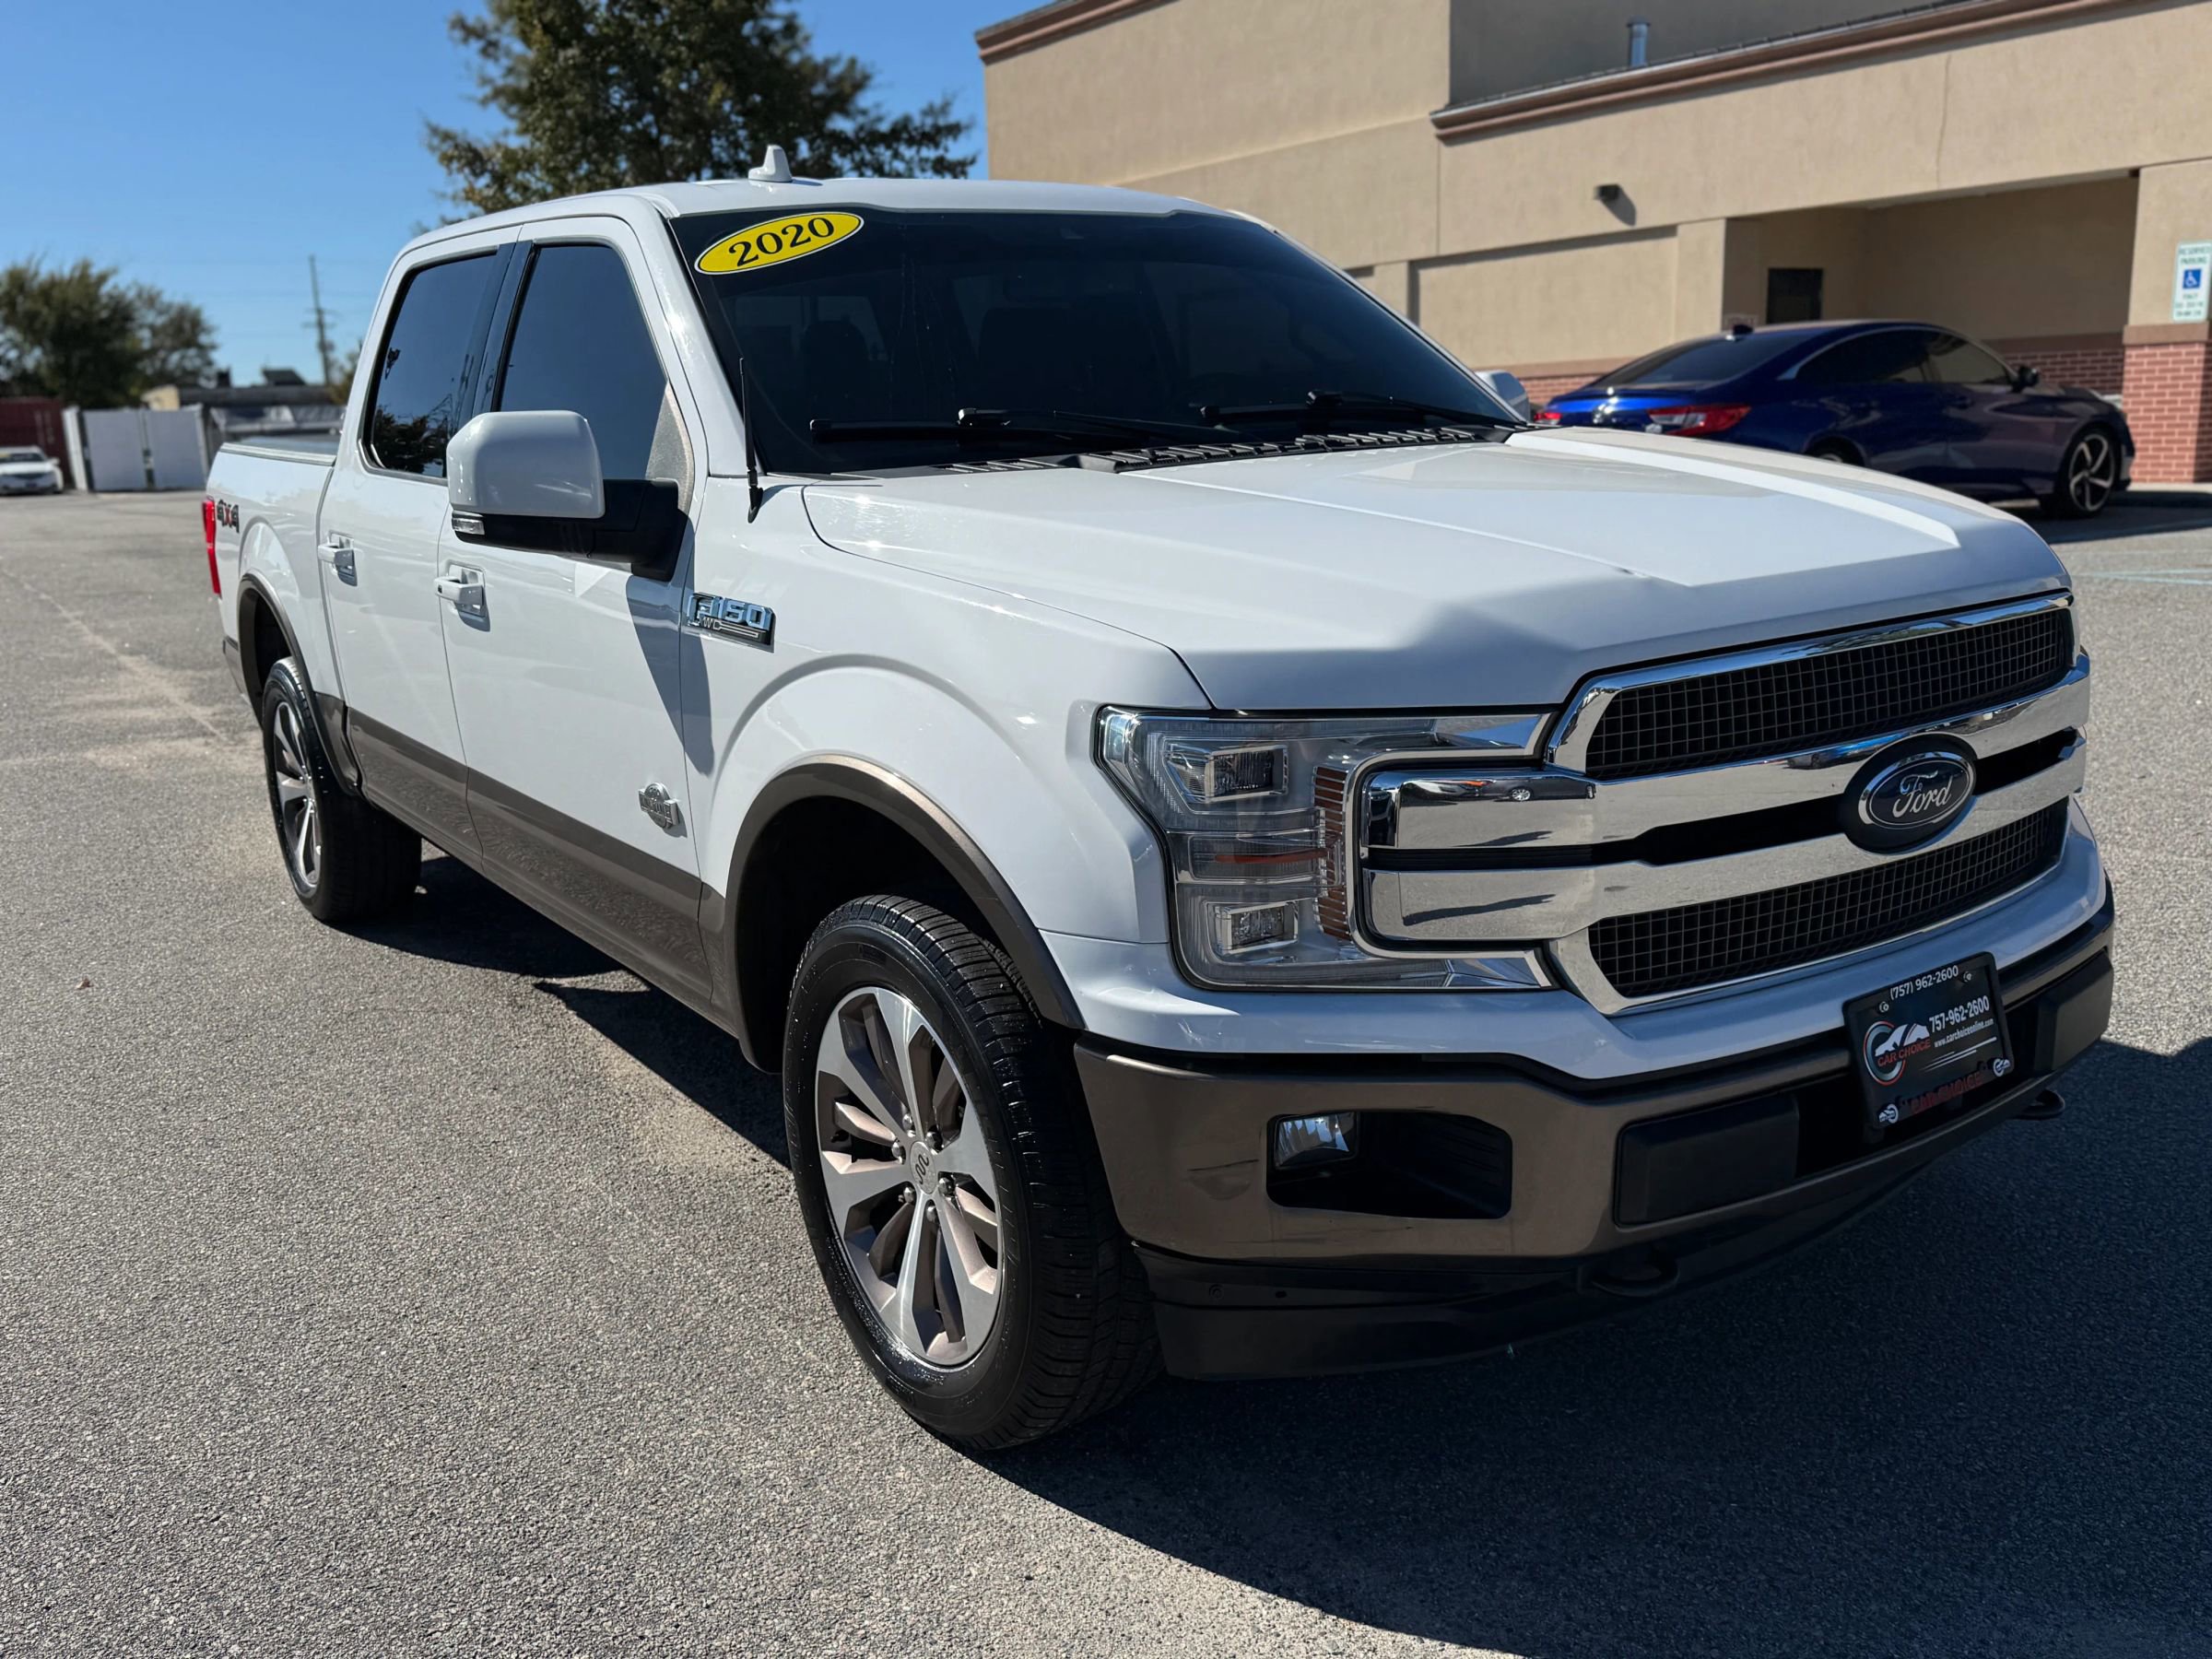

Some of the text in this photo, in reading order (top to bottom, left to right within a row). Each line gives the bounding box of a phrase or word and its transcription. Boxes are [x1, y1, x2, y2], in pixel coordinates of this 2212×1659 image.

[728, 217, 835, 267] 2020
[1892, 770, 1953, 818] Ford
[1889, 964, 1959, 1001] (757) 962-2600
[1928, 994, 1991, 1033] 757-962-2600
[1877, 1038, 1932, 1067] CAR CHOICE
